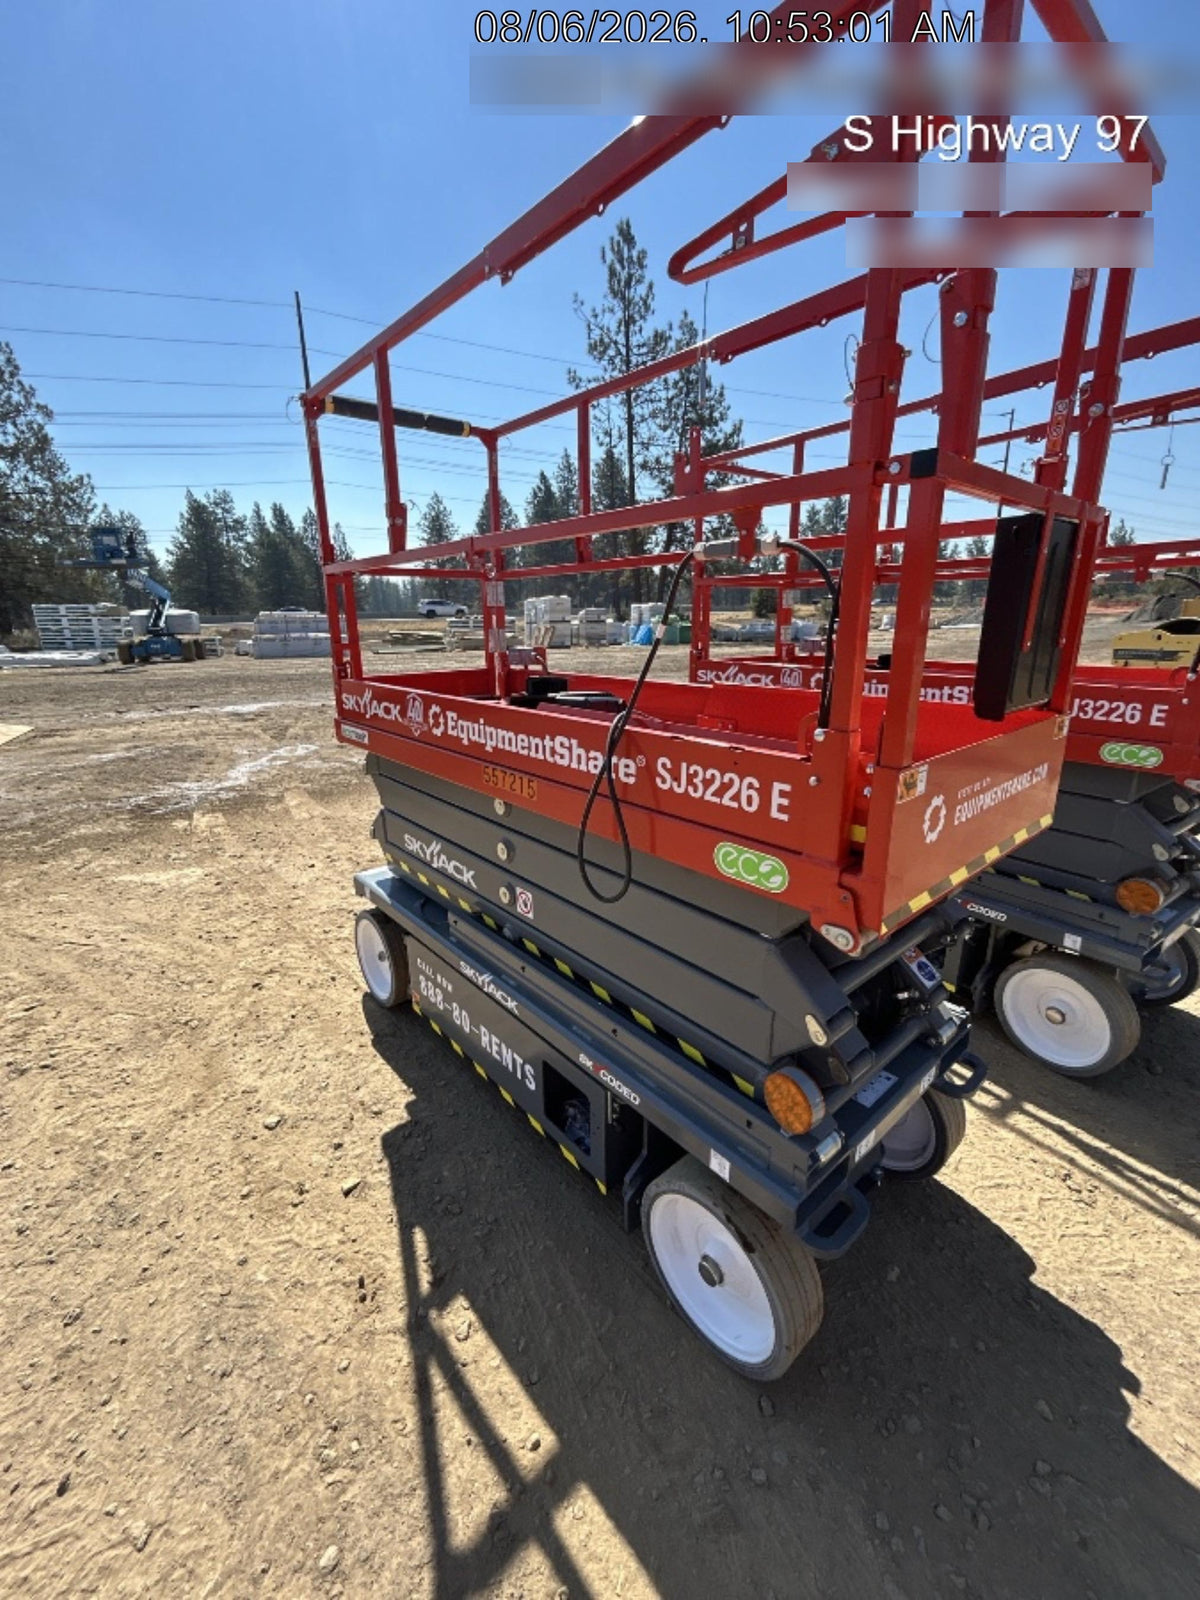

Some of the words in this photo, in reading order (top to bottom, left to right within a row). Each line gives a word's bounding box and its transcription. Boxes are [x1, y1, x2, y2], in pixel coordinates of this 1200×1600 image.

[696, 665, 776, 688] SKYJACK
[342, 688, 404, 722] SKYJACK
[1070, 698, 1142, 724] J3226
[1149, 704, 1169, 726] E
[482, 766, 537, 799] 557215
[655, 757, 760, 813] SJ3226
[770, 781, 792, 822] E
[403, 832, 477, 889] SKYJACK
[459, 960, 520, 1016] SKYJACK
[418, 975, 537, 1092] 888-80-RENTS
